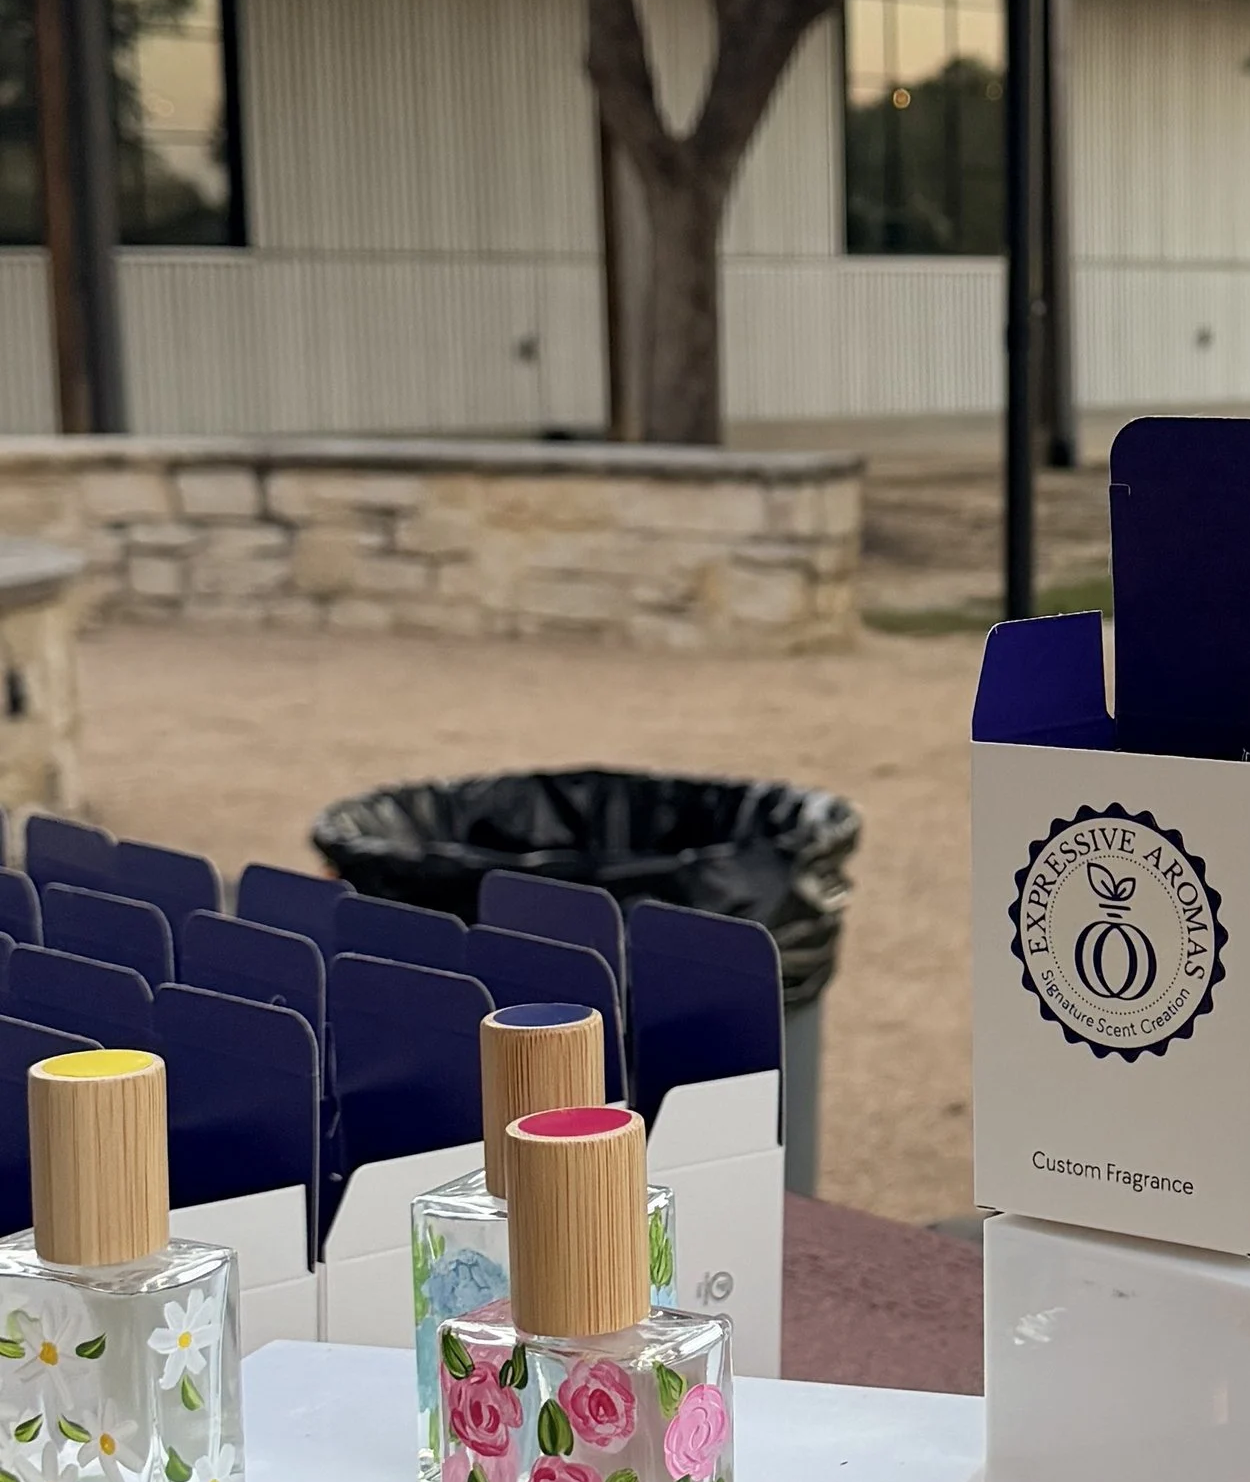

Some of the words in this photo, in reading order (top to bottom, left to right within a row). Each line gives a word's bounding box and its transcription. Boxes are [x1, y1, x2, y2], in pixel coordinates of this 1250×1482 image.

[1027, 827, 1136, 956] EXPRESSIVE
[1142, 846, 1208, 980] AROMAS
[1041, 969, 1095, 1028] Signature
[1096, 1017, 1138, 1038] Scent
[1140, 987, 1191, 1034] Creation
[1032, 1150, 1101, 1181] Custom
[1106, 1163, 1194, 1195] Fragrance
